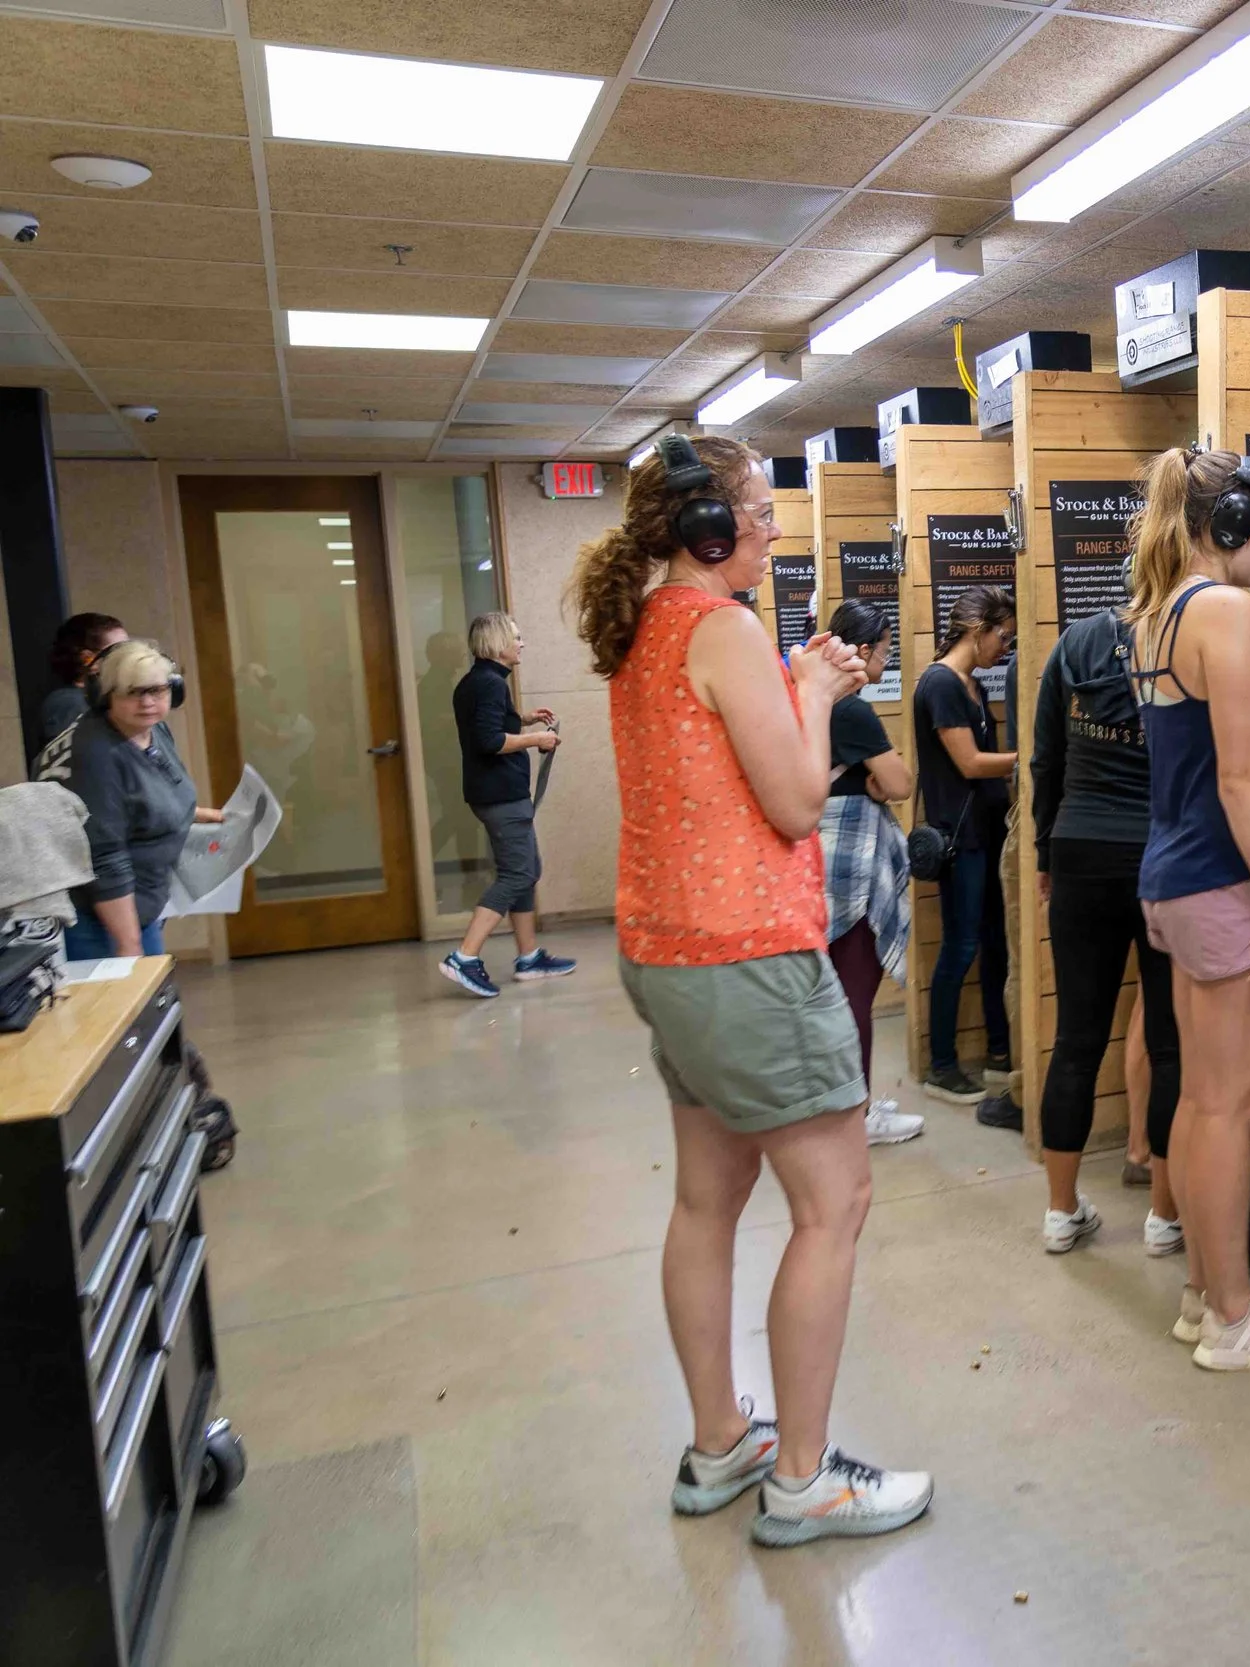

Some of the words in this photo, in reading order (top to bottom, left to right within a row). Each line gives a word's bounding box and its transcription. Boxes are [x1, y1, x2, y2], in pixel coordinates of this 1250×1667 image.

[553, 463, 595, 495] EXIT
[1056, 496, 1100, 511] STOCK
[1102, 498, 1116, 511] &
[1120, 496, 1148, 511] BAR
[933, 528, 971, 540] STOCK
[972, 529, 984, 540] &
[987, 528, 1009, 540] BAR
[1076, 542, 1112, 555] RANGE
[1114, 541, 1134, 553] SAF
[844, 553, 877, 564] STOCK
[879, 554, 889, 563] &
[775, 565, 805, 575] STOCK
[949, 565, 980, 576] RANGE
[983, 564, 1016, 575] SAFETY
[859, 585, 887, 594] RANGE
